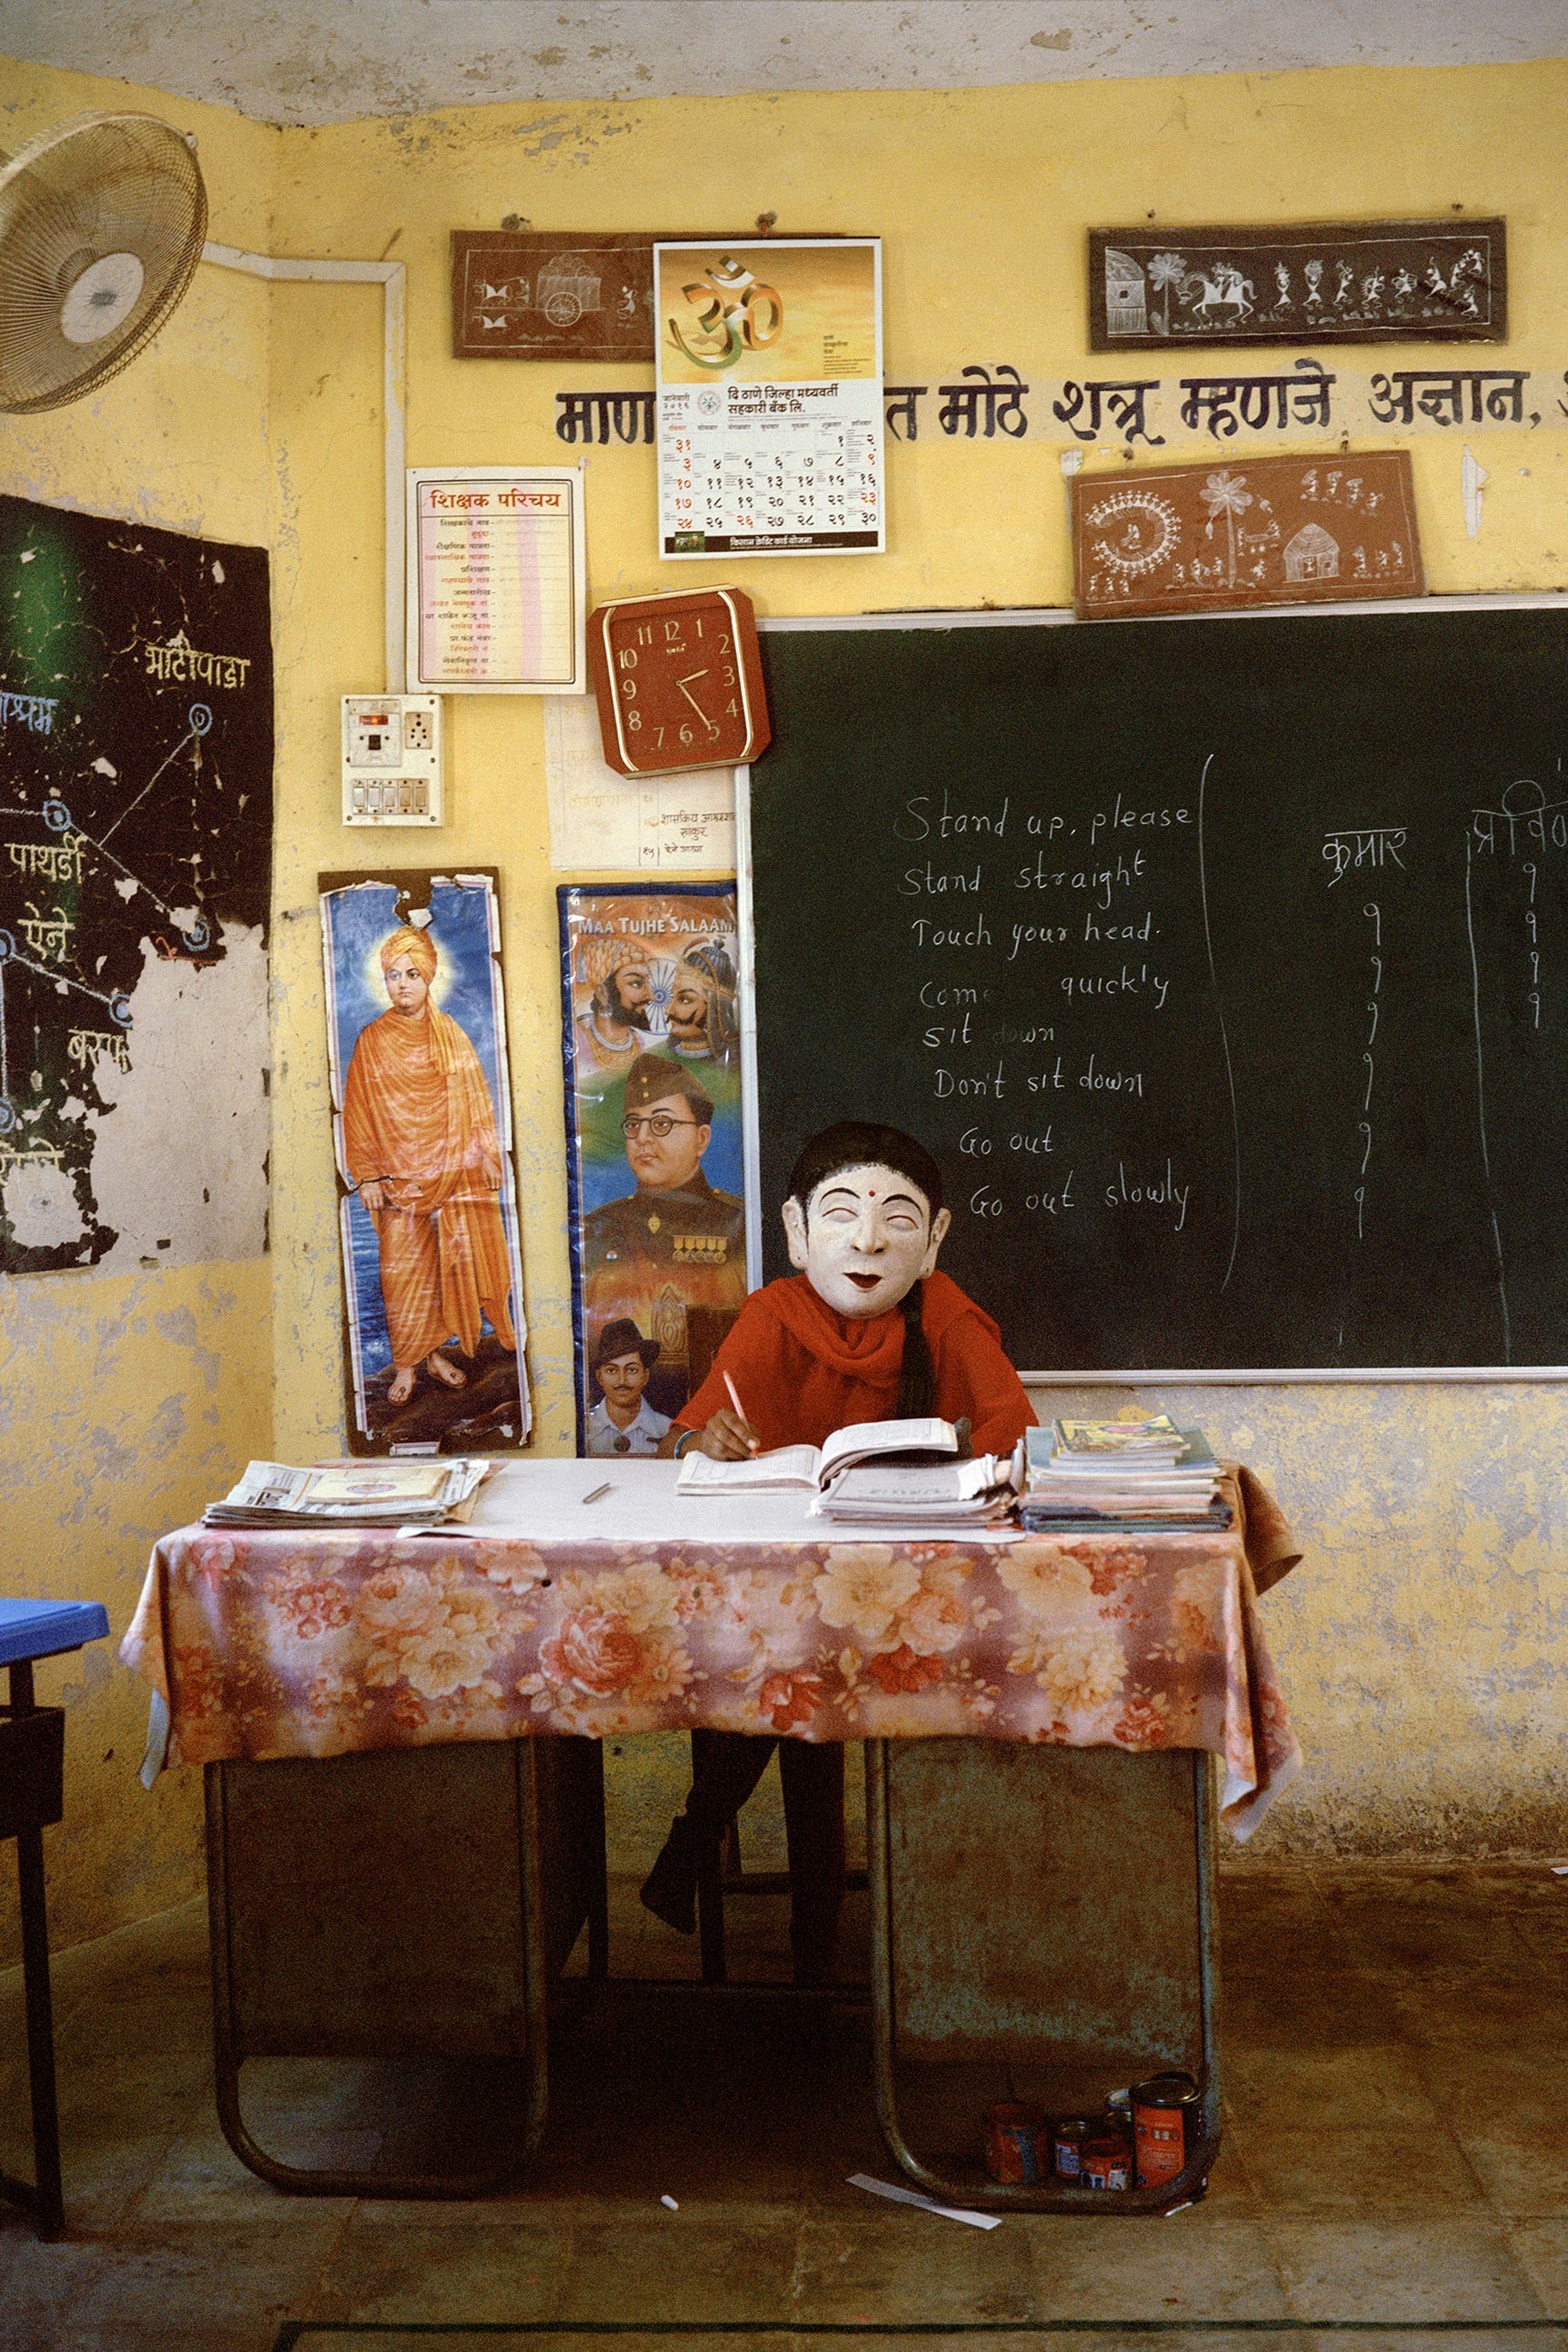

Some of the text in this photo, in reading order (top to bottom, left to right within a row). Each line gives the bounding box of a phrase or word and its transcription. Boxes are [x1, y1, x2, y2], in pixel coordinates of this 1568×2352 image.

[556, 391, 656, 444] माण
[938, 365, 1029, 438] मोठे
[1053, 380, 1166, 445] शत्रू
[1180, 358, 1336, 441] म्हणजे
[728, 383, 839, 400] दि ठाणे जिल्हा मध्यवर्ती
[728, 400, 766, 415] सहकारी
[789, 399, 806, 413] लि.
[676, 434, 875, 452] ३१ १ २
[684, 453, 876, 470] ३ ४ ५ ६ ७ ८ ९
[677, 473, 876, 490] १० ११ १२ १३ १४ १५ १६
[430, 488, 561, 509] शिक्षक परिचय
[675, 492, 877, 510] १७ १८ १९ २० २१ २२ २३
[677, 512, 877, 529] २४ २५ २६ २७ २८ २९ ३०
[637, 625, 652, 645] 11
[664, 621, 681, 641] 12
[695, 618, 703, 637] 1
[718, 633, 731, 655] 2
[618, 648, 638, 669] 10
[722, 666, 735, 687] 3
[622, 679, 637, 700] 9
[725, 698, 739, 717] 4
[629, 710, 642, 731] 8
[708, 720, 720, 741] 5
[653, 727, 666, 747] 7
[680, 723, 694, 743] 6
[893, 788, 1008, 841] Stand
[1091, 793, 1194, 845] please
[1322, 827, 1409, 888] कुमार
[1014, 849, 1147, 909] straight
[578, 916, 735, 935] MAA TUJHE SALAAM
[911, 911, 1161, 961] Touch your head.
[922, 1011, 973, 1047] sit
[933, 1053, 1143, 1099] Don't sit down
[959, 1124, 1054, 1157] Go out
[969, 1157, 1190, 1232] Go out slowly
